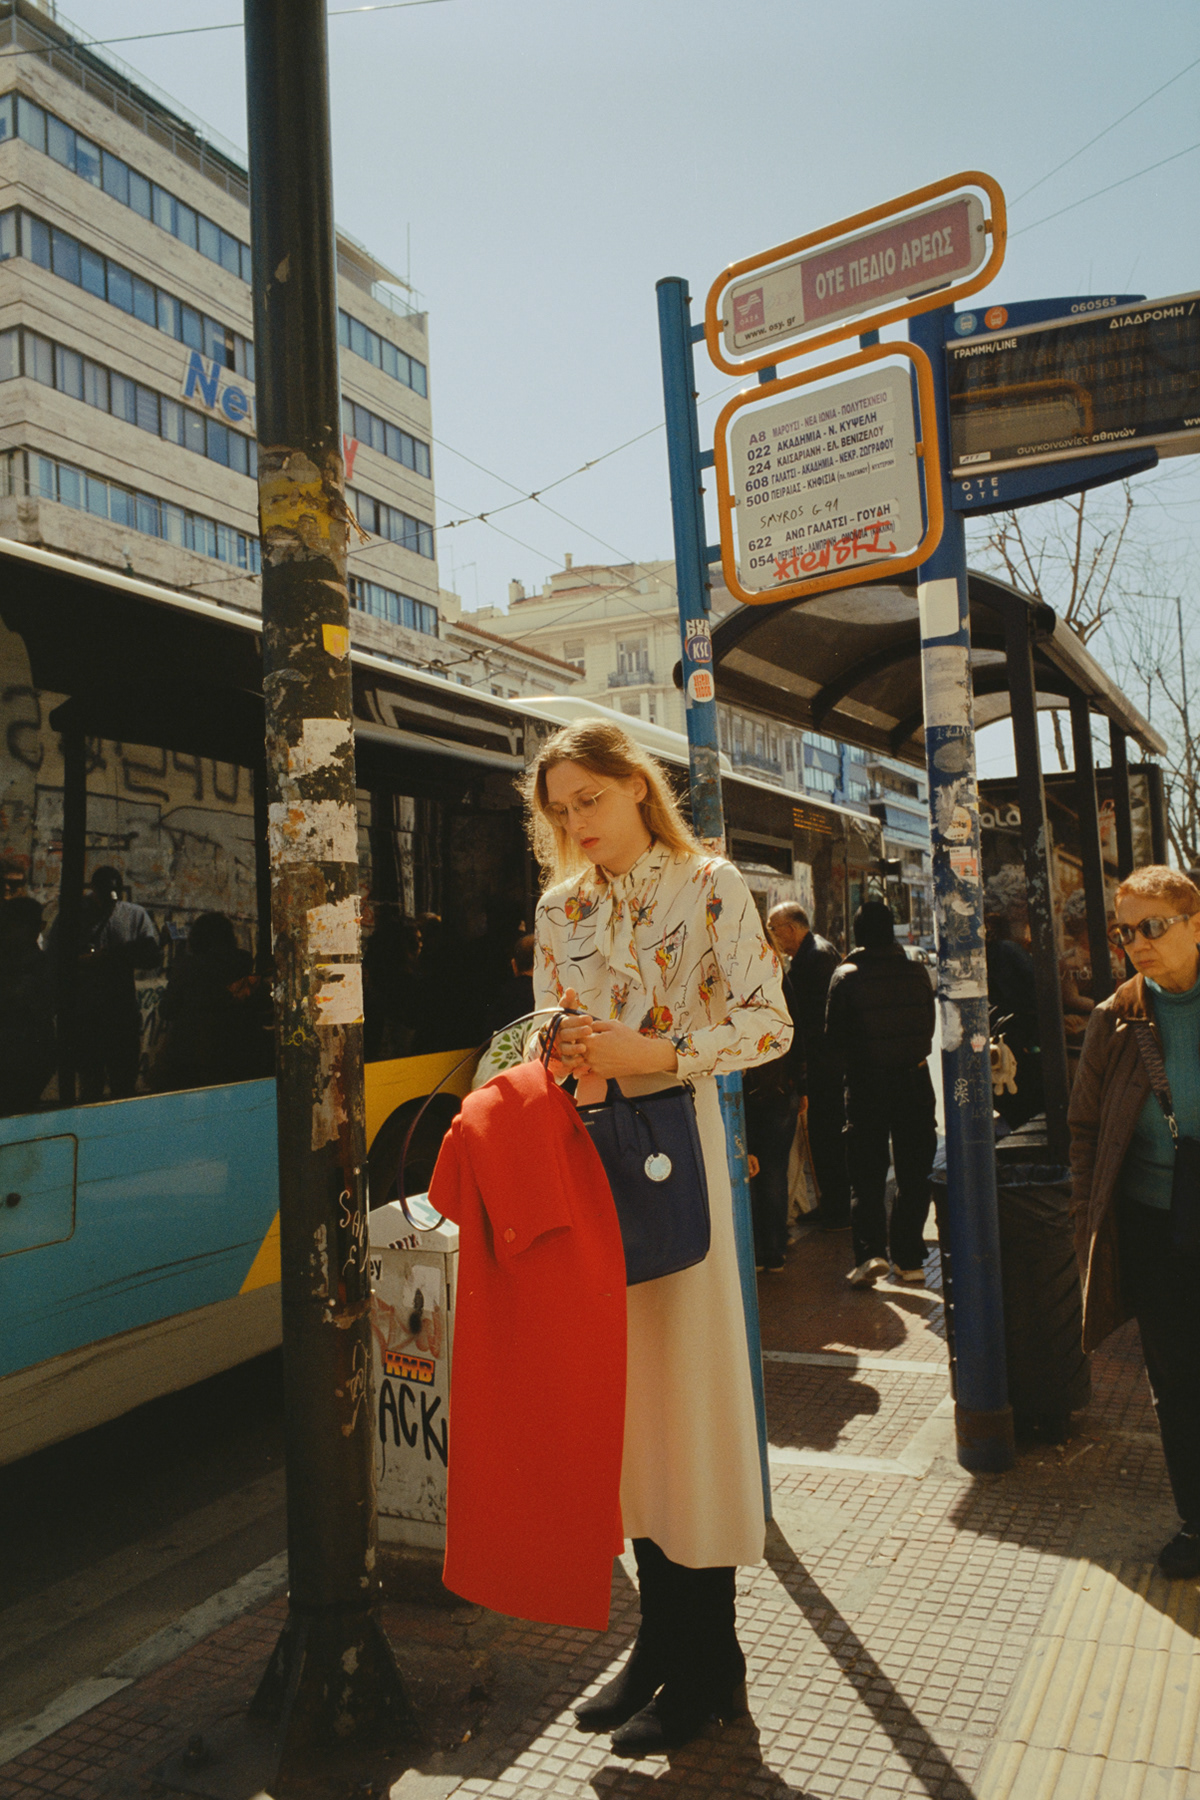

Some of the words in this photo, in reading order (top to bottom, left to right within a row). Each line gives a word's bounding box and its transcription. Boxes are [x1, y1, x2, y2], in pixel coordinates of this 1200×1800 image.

[816, 269, 845, 299] ΟΤΕ
[850, 248, 896, 288] ΠΕΔΙΟ
[901, 226, 954, 269] ΑΡΕΩΣ
[787, 316, 796, 327] gr
[1071, 296, 1117, 313] 060565
[1109, 305, 1184, 329] ΔΙΑΔΡΟΜΗ
[954, 338, 1018, 359] ΓΡΑΜΜΗ/LINE
[182, 350, 257, 426] Ne
[747, 445, 771, 461] 022
[777, 430, 822, 452] ΑΚΑΔΗΜΙΑ
[828, 424, 838, 436] Ν.
[839, 411, 877, 432] ΚΥΨΕΛΗ
[749, 431, 766, 446] A8
[772, 420, 800, 437] ΜΑΡΟΥΣΙ
[804, 415, 818, 428] ΝΕΑ
[818, 409, 837, 422] ΙΩΝΙΑ
[841, 392, 887, 415] ΠΟΛΥΤΕΧΝΕΙΟ
[748, 460, 771, 476] 224
[777, 445, 822, 467] ΚΑΙΣΑΡΙΑΝΗ
[827, 440, 840, 452] ΕΛ.
[841, 425, 884, 447] ΒΕΝΙΖΕΛΟΥ
[1017, 436, 1089, 455] συγκοινωνίες
[1092, 427, 1136, 442] αθηνών
[745, 476, 769, 492] 608
[771, 468, 797, 484] ΓΑΛΑΤΣΙ
[802, 457, 834, 476] ΑΚΑΔΗΜΙΑ
[839, 449, 859, 463] ΝΕΚΡ.
[859, 437, 894, 457] ΖΩΓΡΑΦΟΥ
[746, 491, 770, 507] 500
[771, 482, 801, 500] ΠΕΙΡΑΙΑΣ
[807, 472, 836, 490] ΚΗΦΙΣΙΑ
[748, 536, 772, 551] 622
[786, 528, 805, 542] ΑΝΩ
[807, 515, 848, 536] ΓΑΛΑΤΣΙ
[857, 503, 891, 522] ΓΟΥΔΗ
[749, 552, 775, 569] 054
